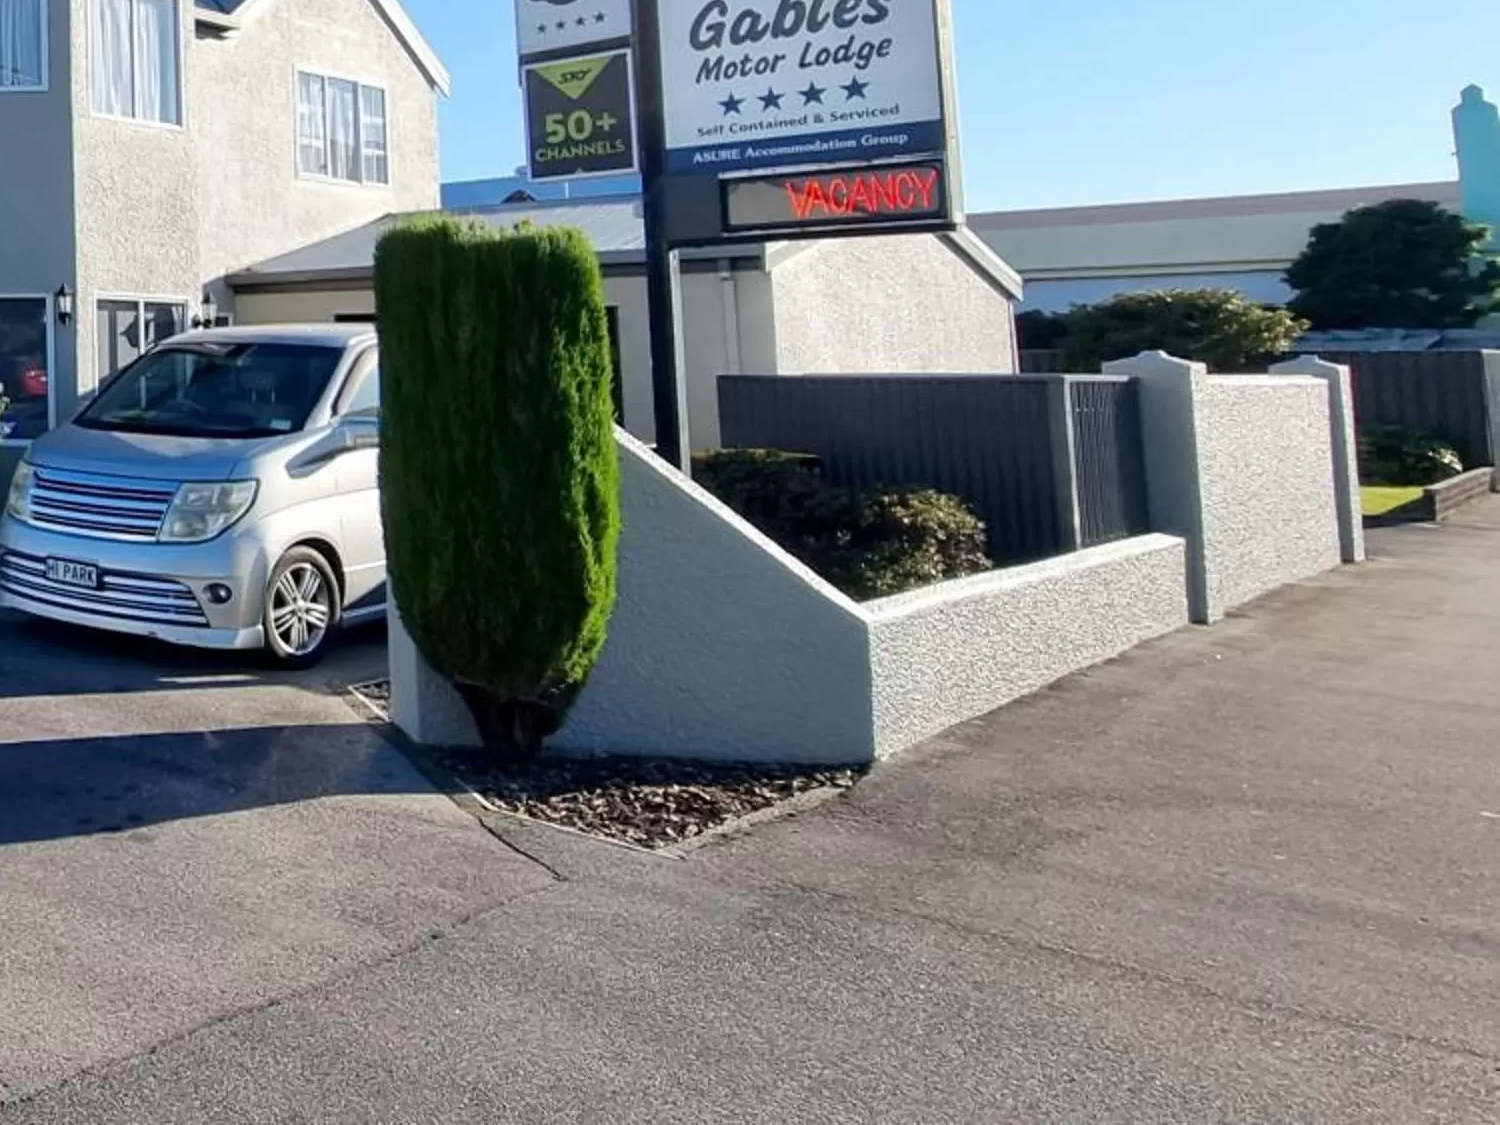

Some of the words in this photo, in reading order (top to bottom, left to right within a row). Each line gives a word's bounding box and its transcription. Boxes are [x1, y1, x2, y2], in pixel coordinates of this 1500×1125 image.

[695, 53, 787, 84] Motor
[798, 36, 893, 70] Lodge
[545, 110, 618, 144] 50+
[697, 125, 724, 138] Self
[729, 113, 808, 135] Contained
[813, 111, 826, 124] &
[830, 103, 901, 123] Serviced
[535, 138, 626, 162] CHANNELS
[693, 148, 741, 165] ASURE
[860, 132, 909, 148] Group
[786, 169, 940, 219] VACANCY
[64, 564, 95, 585] PARK
